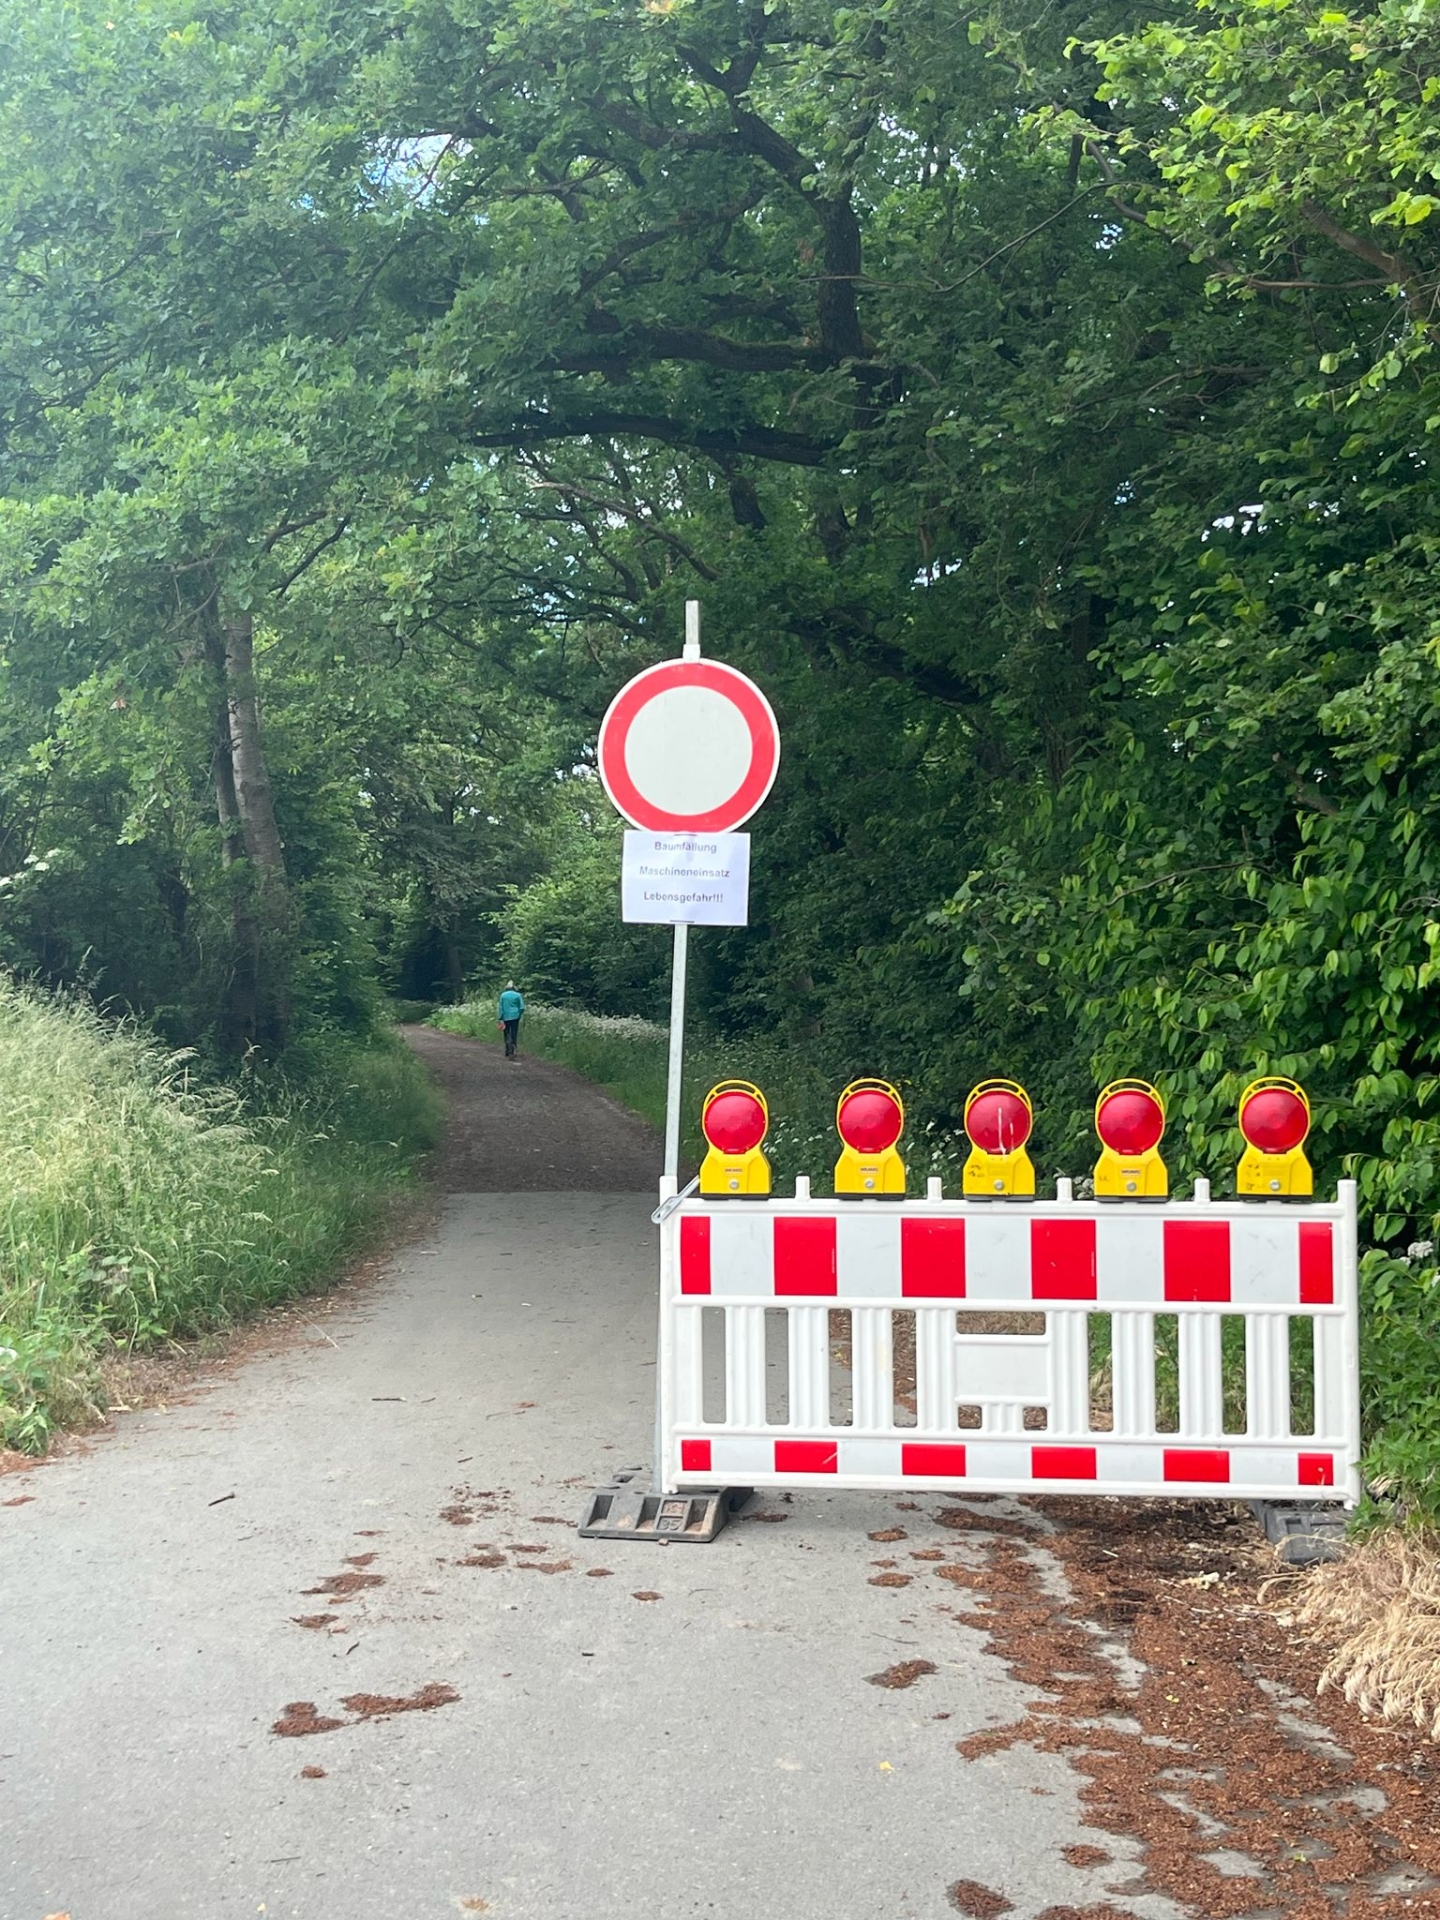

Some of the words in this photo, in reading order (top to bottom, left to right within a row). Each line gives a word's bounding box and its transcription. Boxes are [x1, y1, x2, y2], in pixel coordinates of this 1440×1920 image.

[654, 842, 717, 854] Baumfällung
[639, 866, 730, 878] Maschineneinsatz
[644, 891, 723, 904] Lebensgefahr!!!
